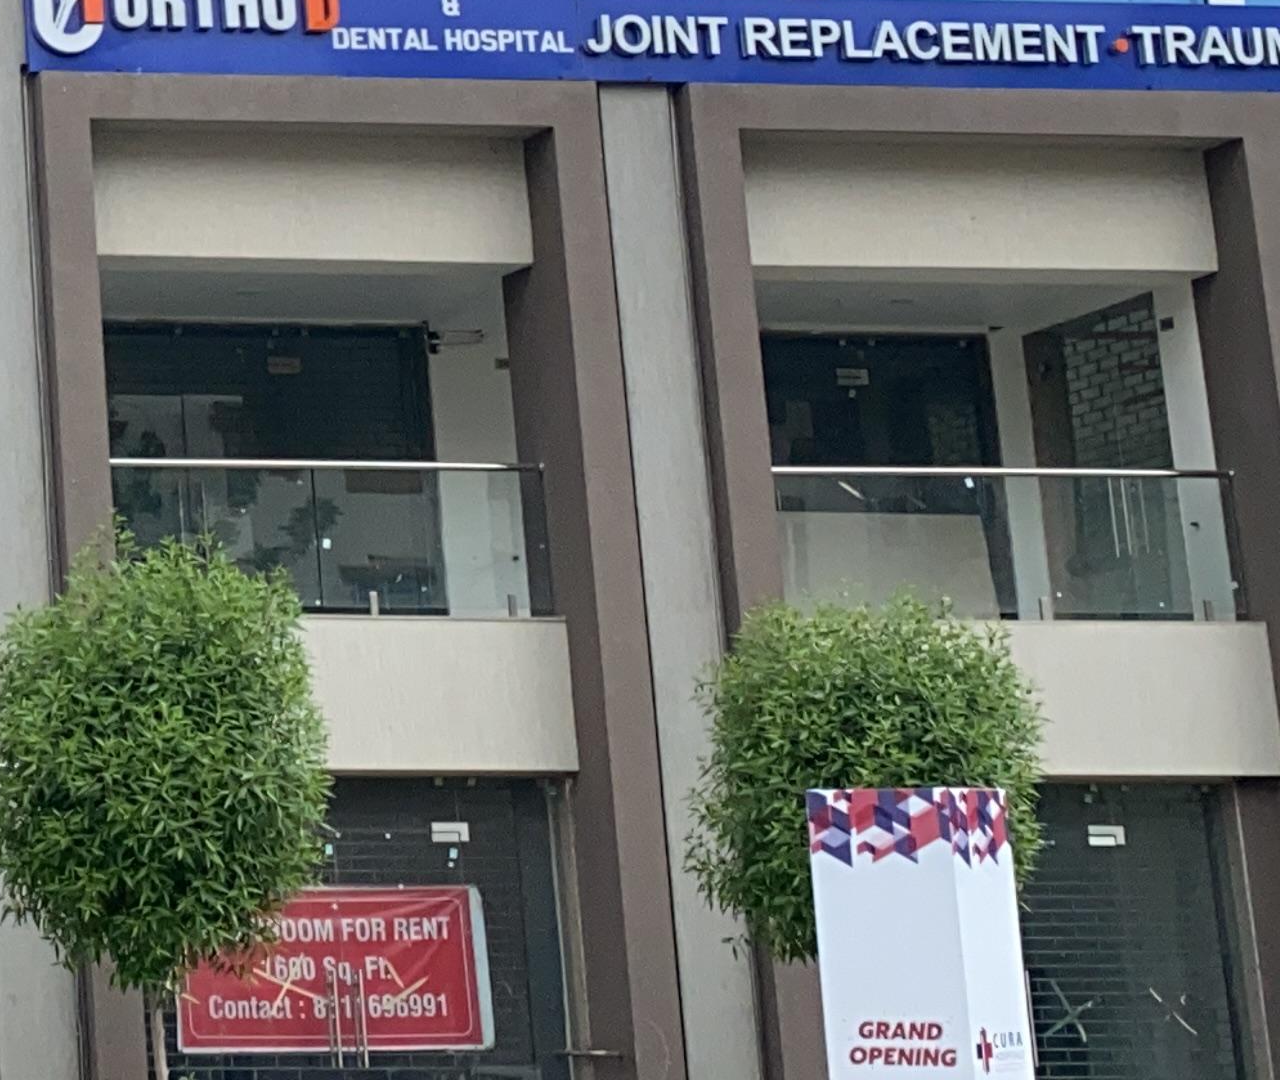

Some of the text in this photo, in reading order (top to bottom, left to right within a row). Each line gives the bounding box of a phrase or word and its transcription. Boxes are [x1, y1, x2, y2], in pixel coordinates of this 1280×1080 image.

[332, 27, 575, 54] DENTAL HOSPITAL
[587, 13, 728, 58] JOINT
[744, 16, 1105, 66] REPLACEMENT
[342, 918, 386, 942] FOR
[394, 917, 450, 941] RENT
[209, 994, 292, 1019] Contact
[858, 1021, 943, 1041] GRAND
[849, 1047, 957, 1067] OPENING
